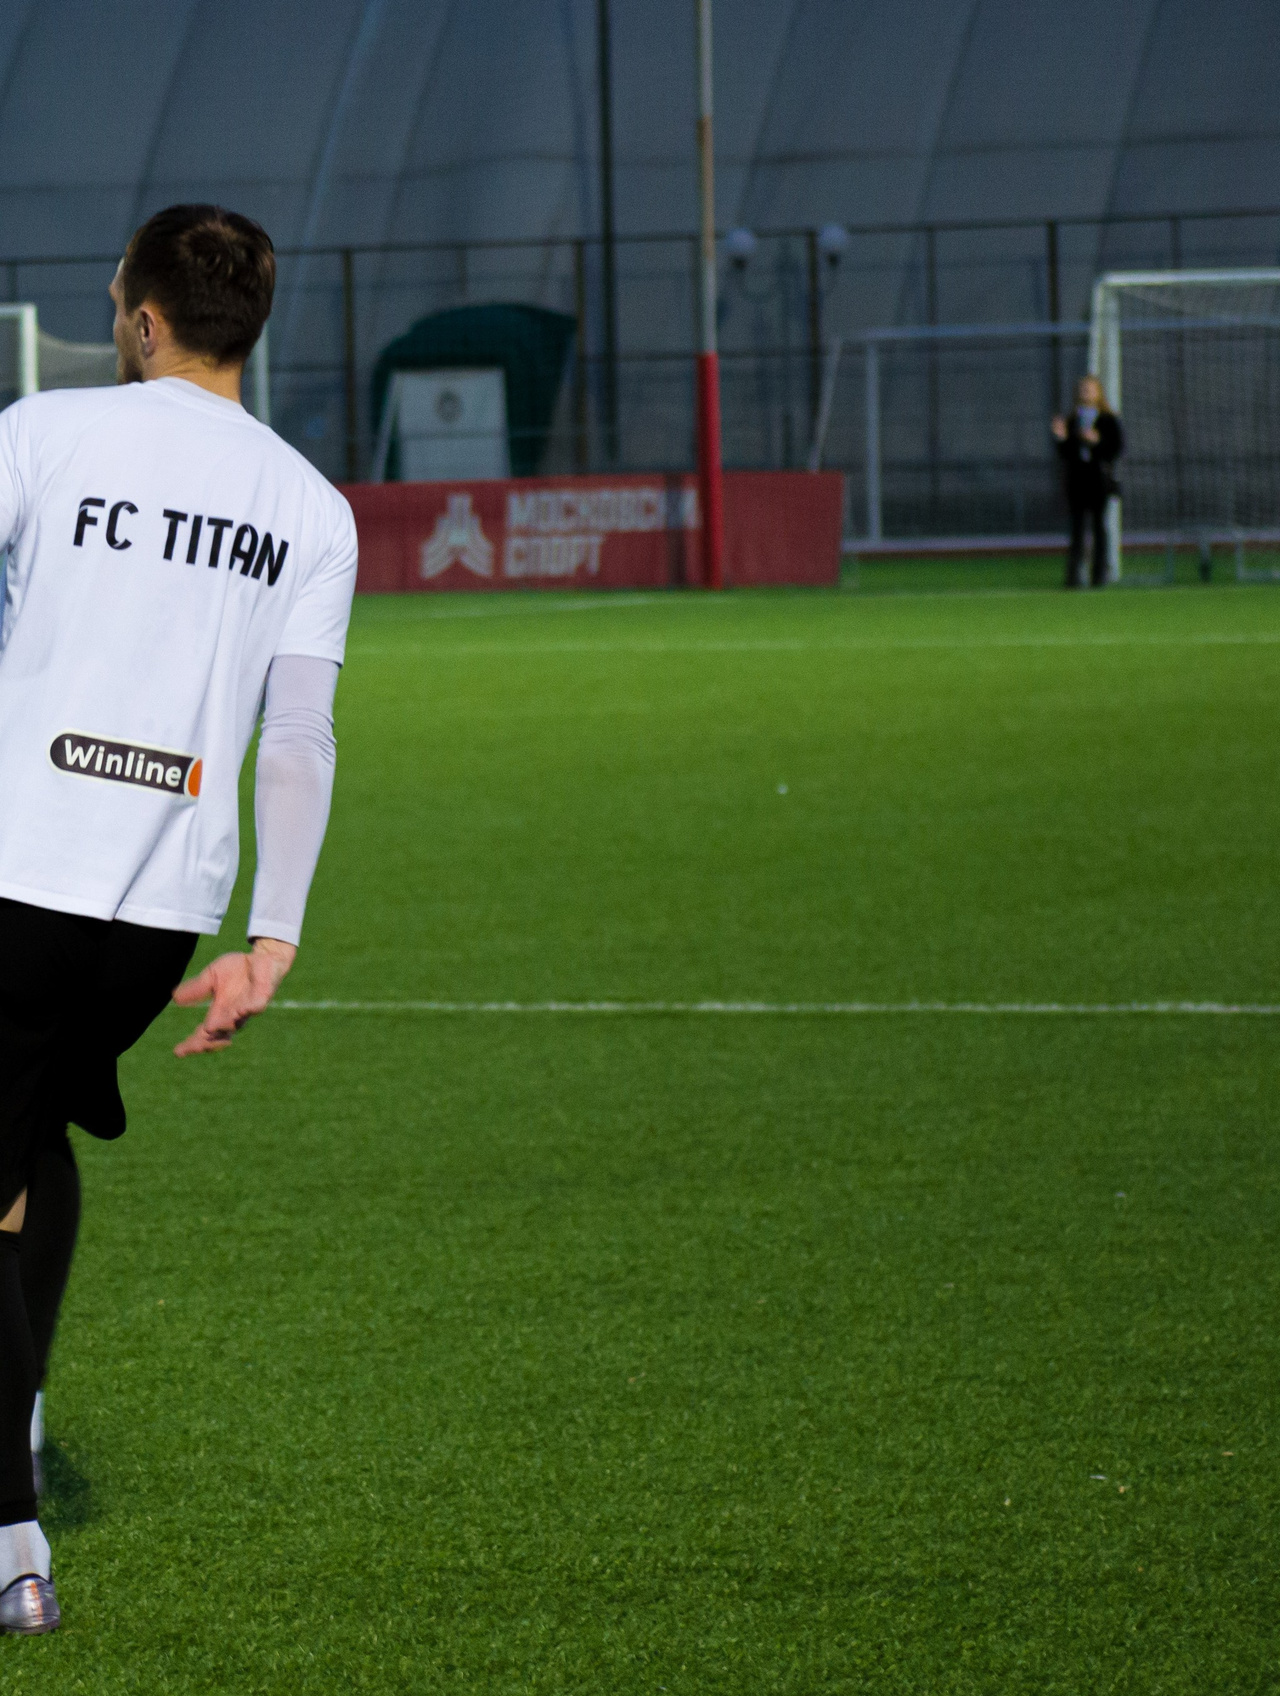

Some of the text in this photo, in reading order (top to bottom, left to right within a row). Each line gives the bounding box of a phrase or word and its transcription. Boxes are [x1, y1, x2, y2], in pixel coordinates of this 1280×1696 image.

[73, 497, 289, 586] FC TITAN
[64, 738, 182, 788] Winline
